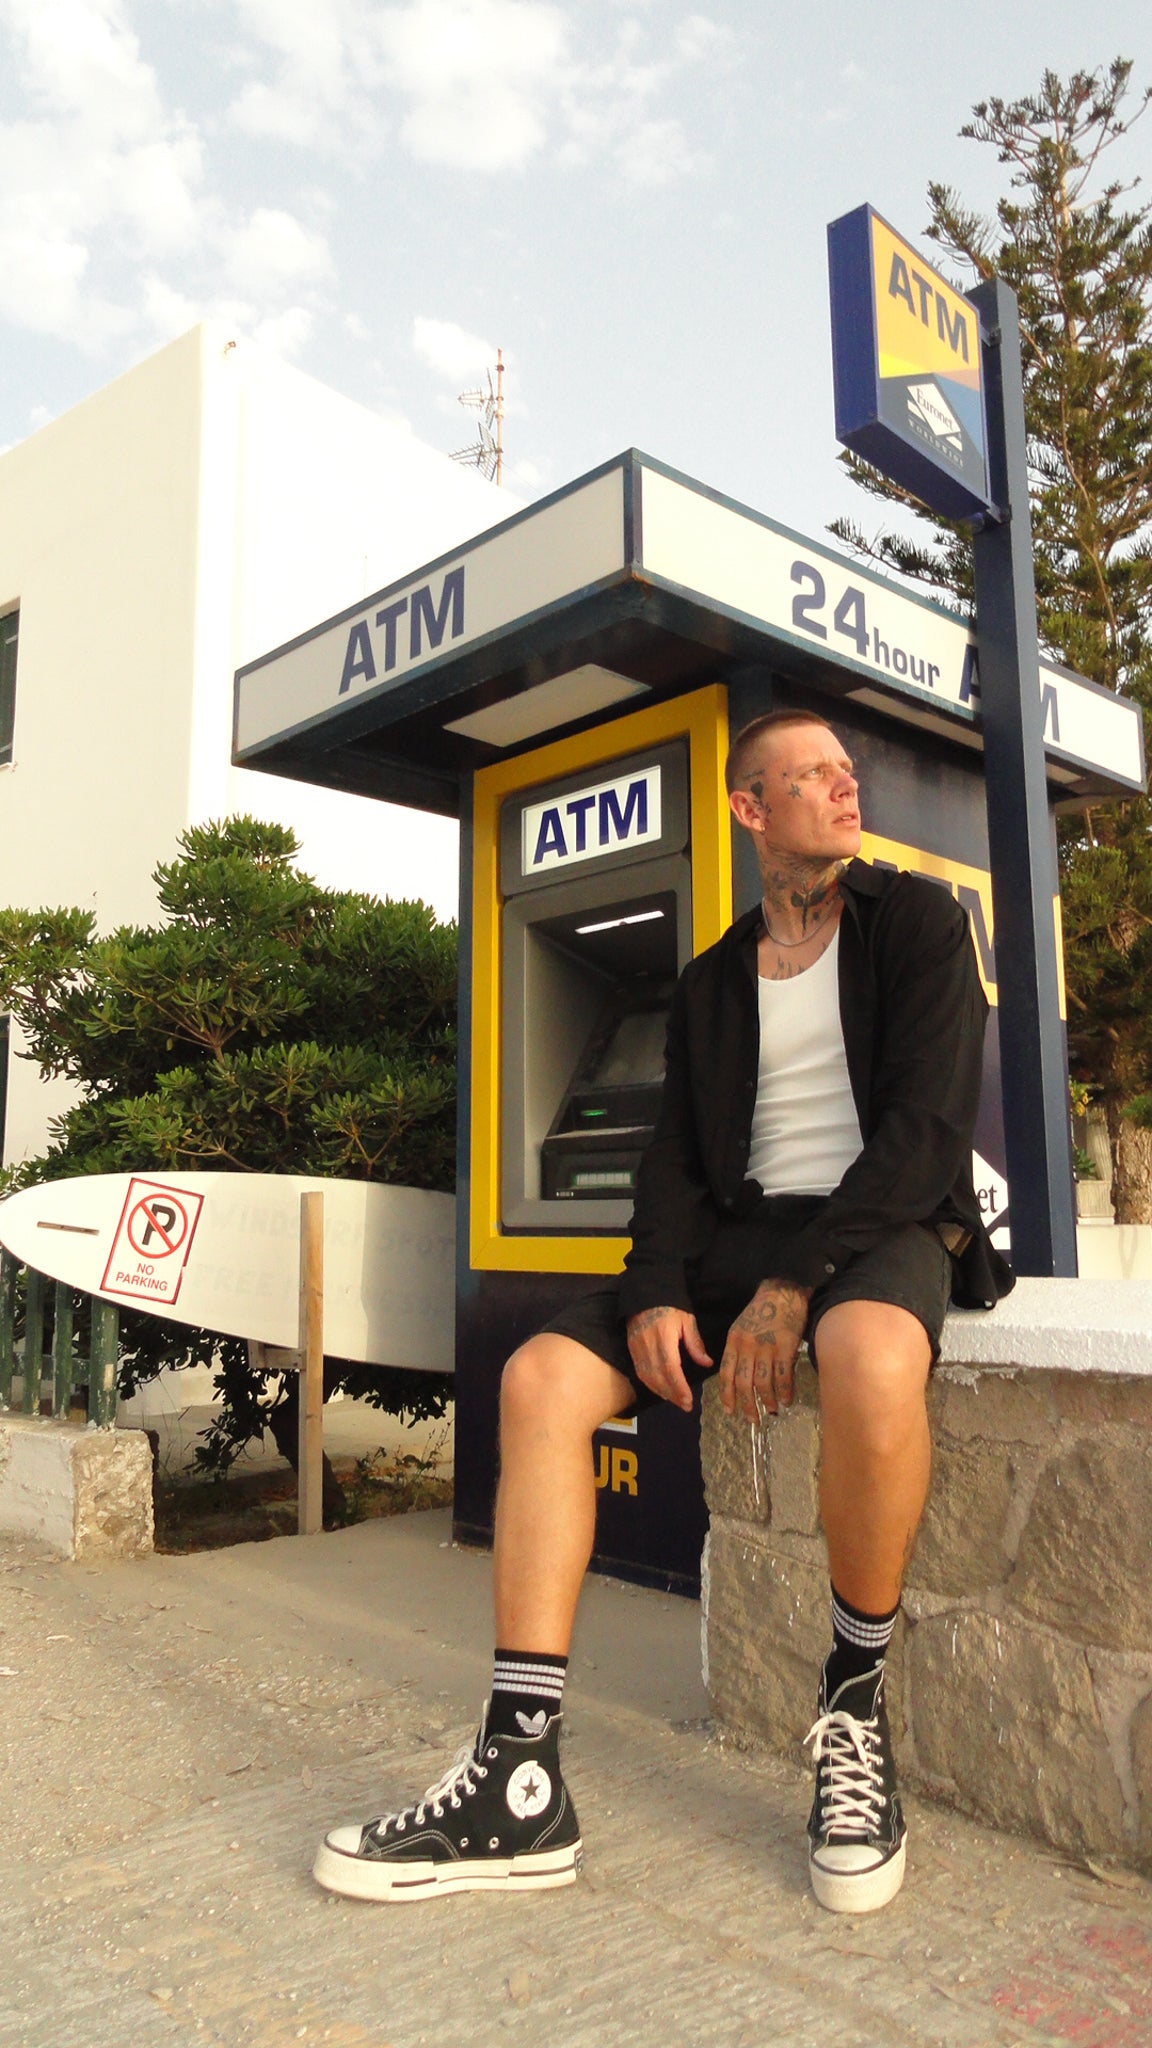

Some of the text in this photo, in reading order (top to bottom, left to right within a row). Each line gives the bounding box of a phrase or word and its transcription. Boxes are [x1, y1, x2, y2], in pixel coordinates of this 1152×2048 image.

[888, 251, 969, 364] ATM
[338, 565, 465, 696] ATM
[532, 778, 648, 865] ATM
[115, 1272, 168, 1291] PARKING
[136, 1263, 155, 1276] NO
